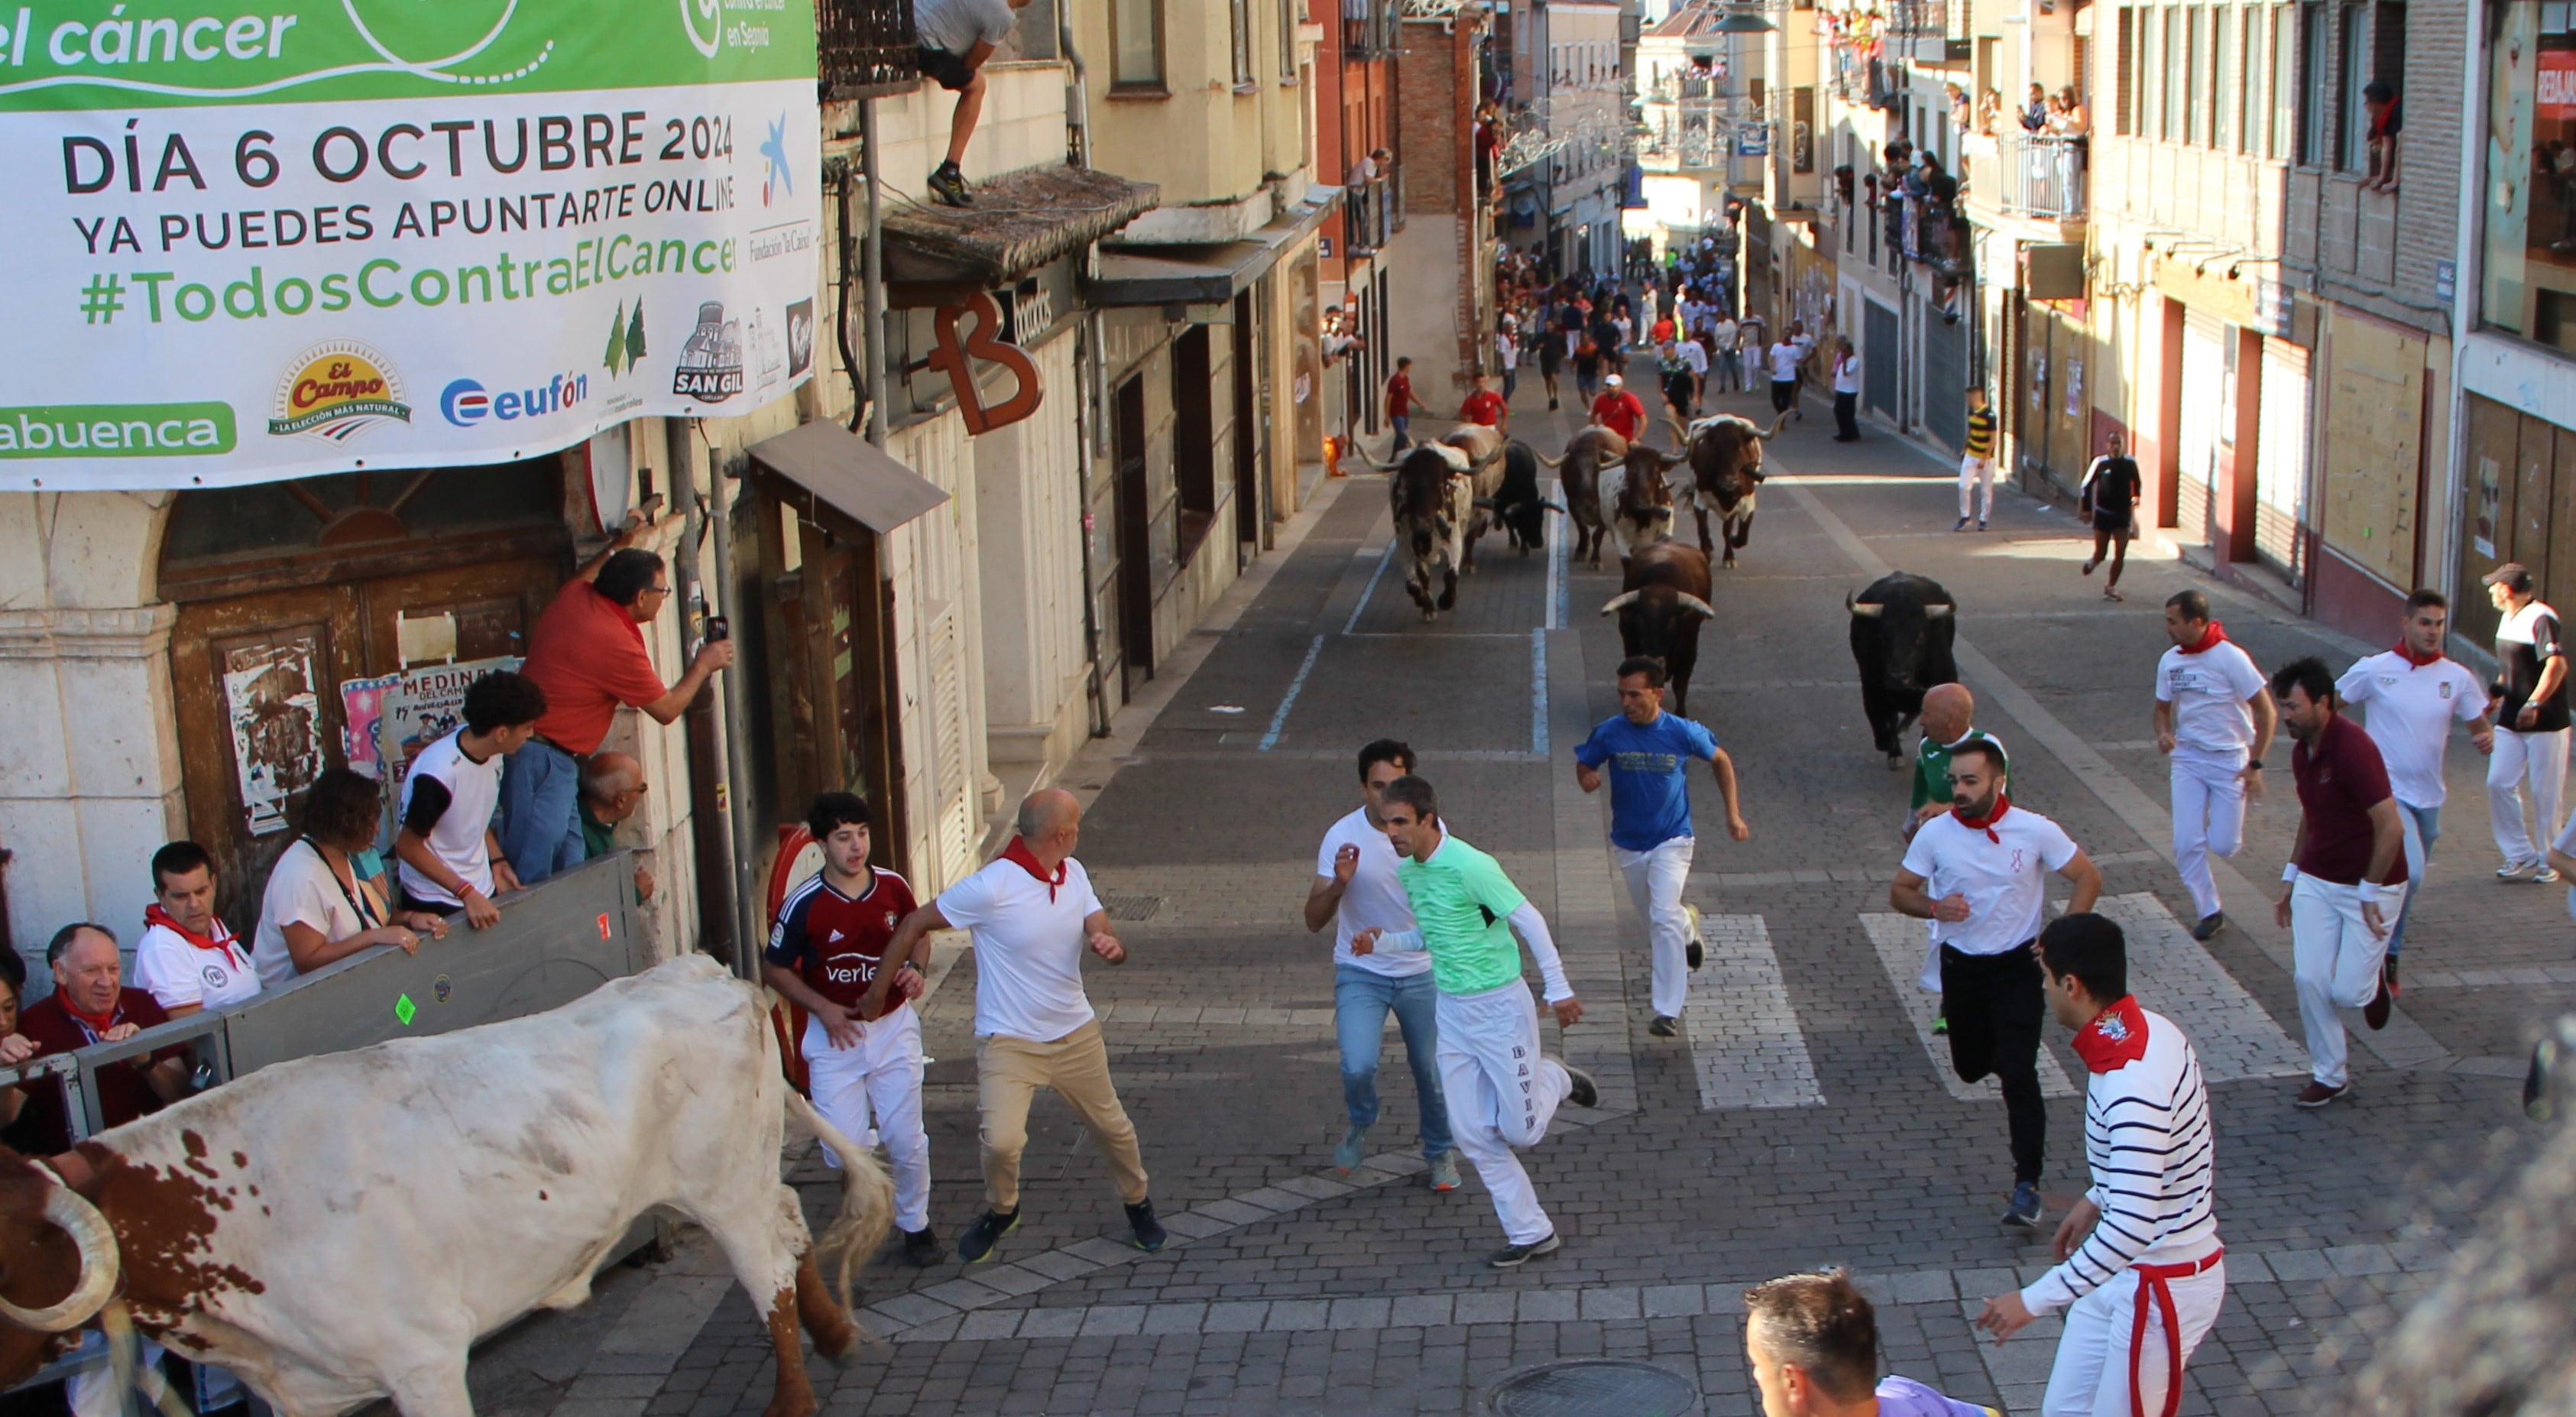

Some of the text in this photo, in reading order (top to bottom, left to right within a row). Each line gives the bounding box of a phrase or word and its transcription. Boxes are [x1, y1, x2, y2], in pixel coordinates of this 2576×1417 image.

[0, 4, 297, 66] l cáncer
[62, 111, 733, 195] DÍA 6 OCTUBRE 2024
[73, 176, 734, 255] YA PUEDES APUNTARTE ONLINE
[79, 233, 738, 325] #TodosContraElCancer
[292, 378, 384, 408] Campo
[328, 362, 352, 380] El
[676, 374, 718, 394] SAN
[721, 373, 743, 393] GIL
[494, 369, 588, 420] eufón
[0, 413, 220, 450] abuenca
[280, 423, 291, 432] LA
[292, 410, 332, 430] ELECCIÓN
[356, 404, 399, 415] NATURAL
[420, 689, 437, 700] DEL
[1512, 1044, 1537, 1130] DAVID
